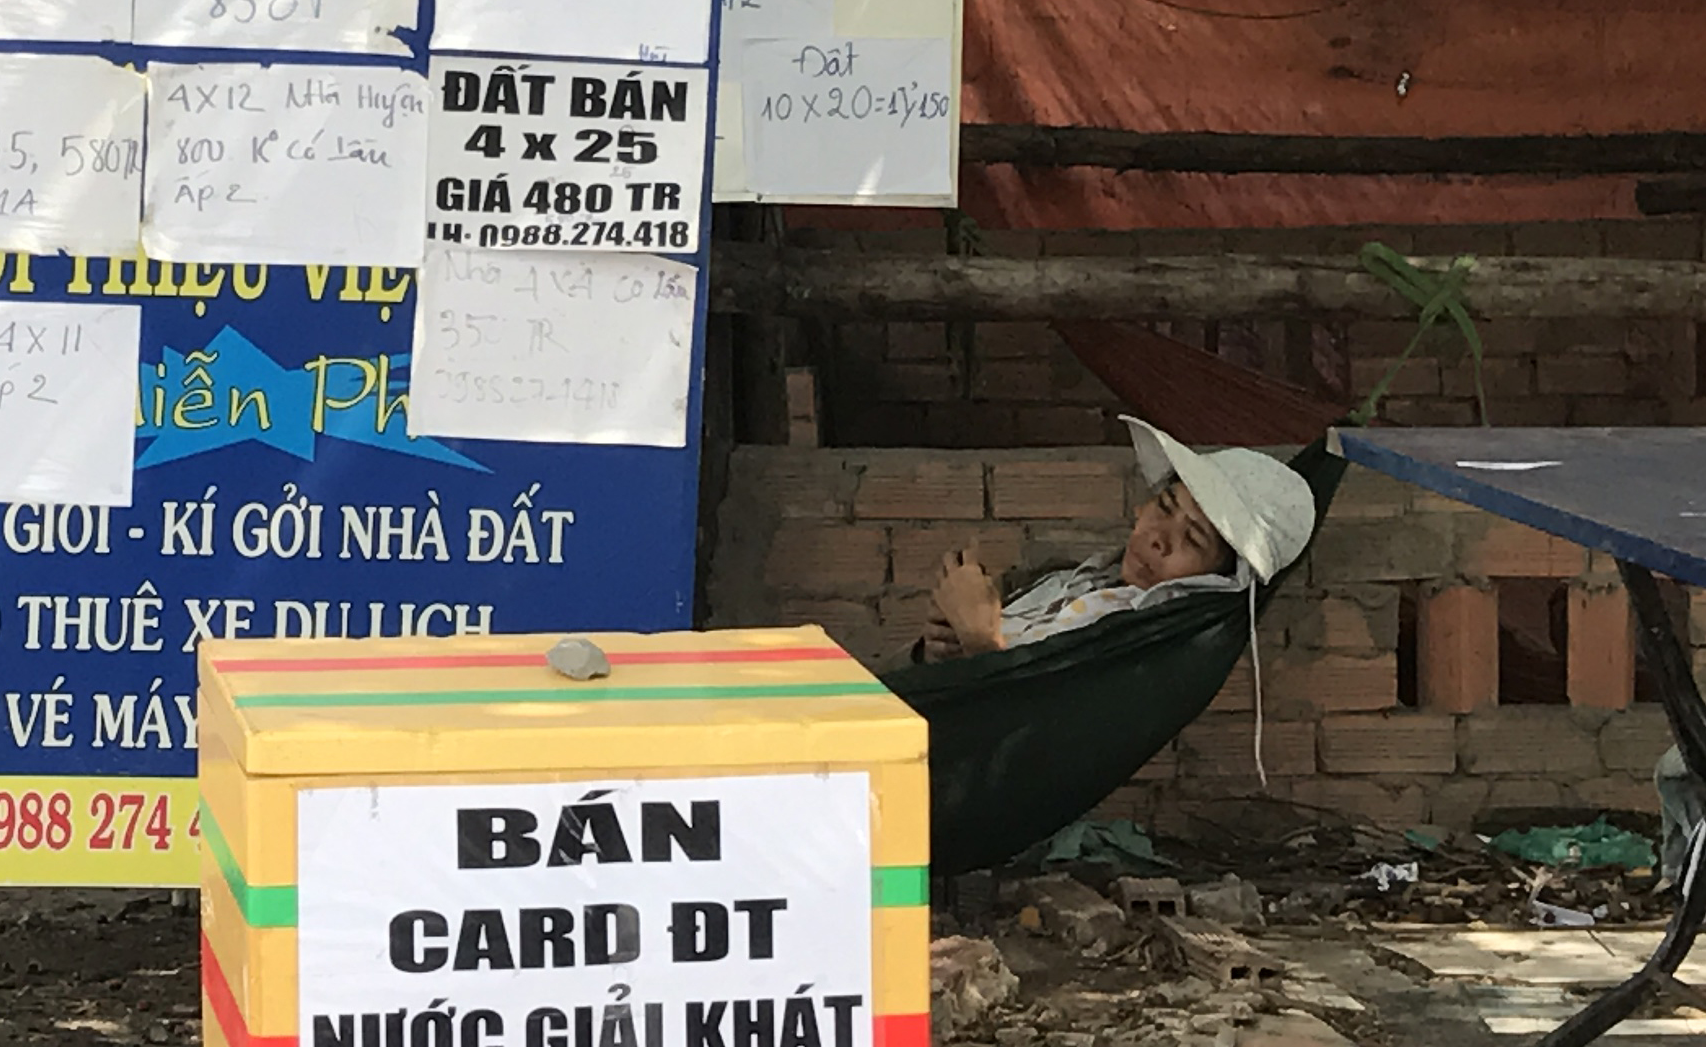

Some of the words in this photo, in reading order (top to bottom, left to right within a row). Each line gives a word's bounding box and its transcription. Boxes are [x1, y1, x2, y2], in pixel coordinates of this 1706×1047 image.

[441, 64, 556, 116] ĐẤT
[569, 70, 689, 123] BÁN
[464, 124, 507, 159] 4
[573, 128, 659, 166] 25
[436, 172, 512, 214] GIÁ
[522, 180, 614, 216] 480
[625, 181, 682, 213] TR
[479, 220, 690, 249] 0988.274.418
[303, 264, 418, 323] VI
[135, 349, 273, 433] iễn
[161, 485, 215, 557] KÍ
[232, 481, 324, 560] GỞI
[340, 489, 451, 563] NHÀ
[467, 481, 575, 565] ĐẤT
[17, 580, 164, 653] THUÊ
[181, 597, 257, 653] XE
[6, 674, 75, 751] VÉ
[92, 676, 199, 751] MÁY
[89, 792, 172, 852] 274
[457, 788, 722, 870] BÁN
[388, 901, 642, 974] CARD
[667, 897, 788, 964] ĐT
[312, 996, 506, 1047] NƯỚC
[524, 983, 665, 1047] GIẢI
[685, 983, 865, 1047] KHÁT
